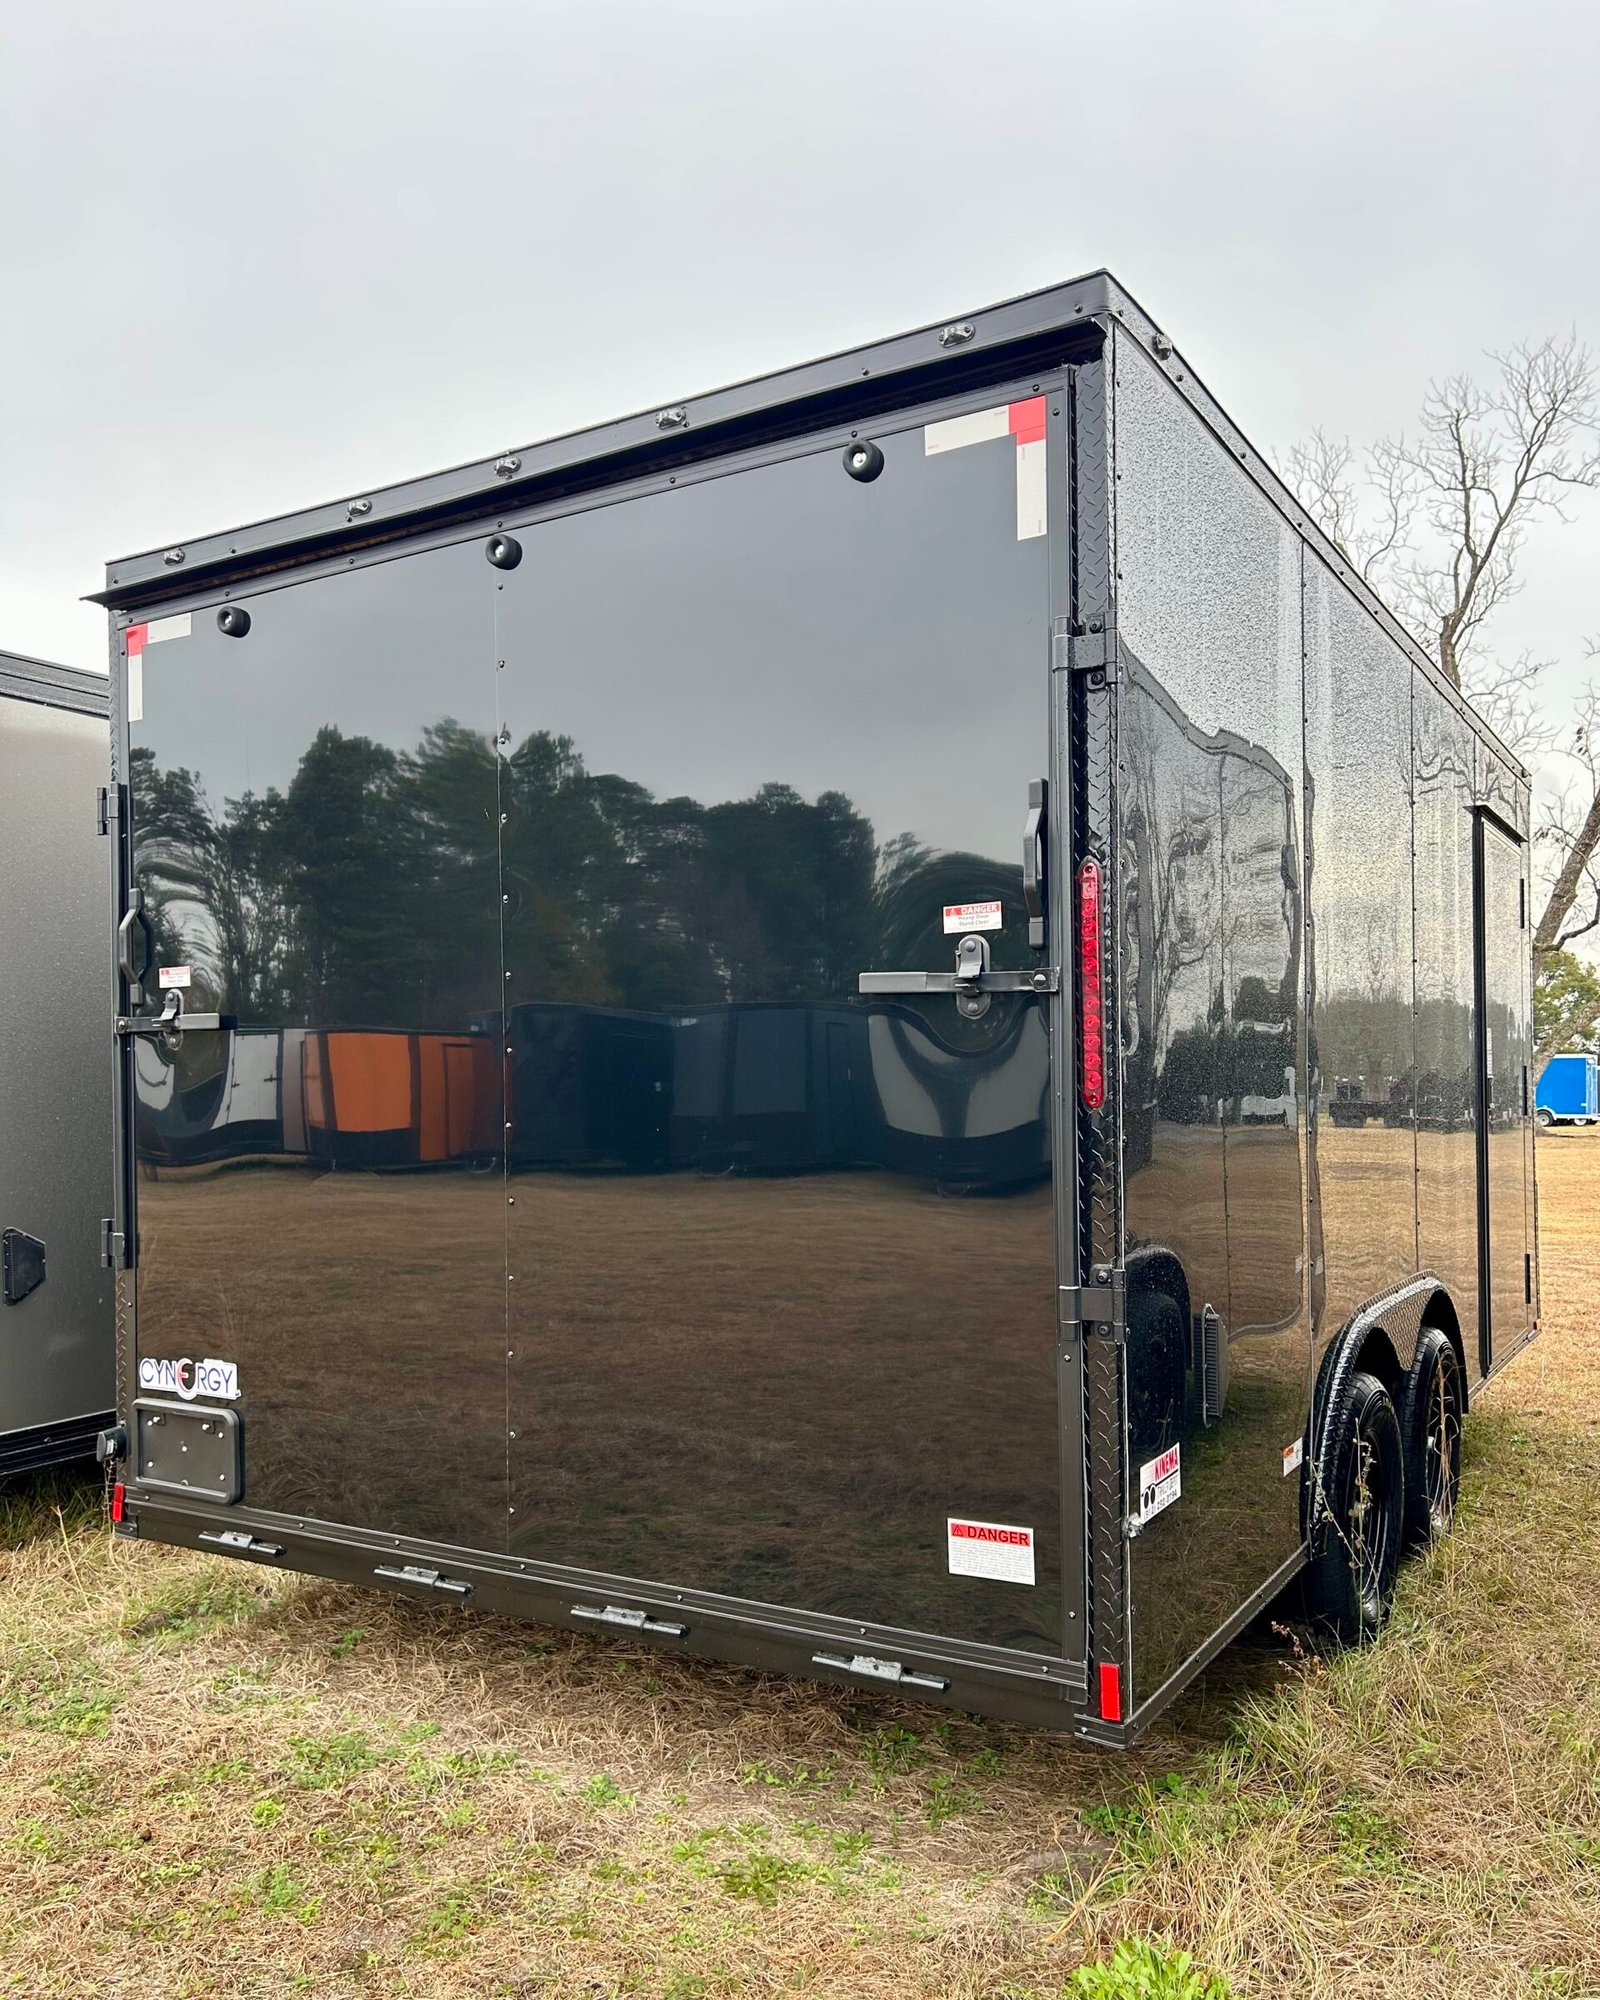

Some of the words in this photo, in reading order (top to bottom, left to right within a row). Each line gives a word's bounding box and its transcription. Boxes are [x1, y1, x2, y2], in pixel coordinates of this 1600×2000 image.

[960, 904, 997, 915] DANGER
[141, 1359, 233, 1393] CYNERGY
[967, 1526, 1029, 1546] DANGER
